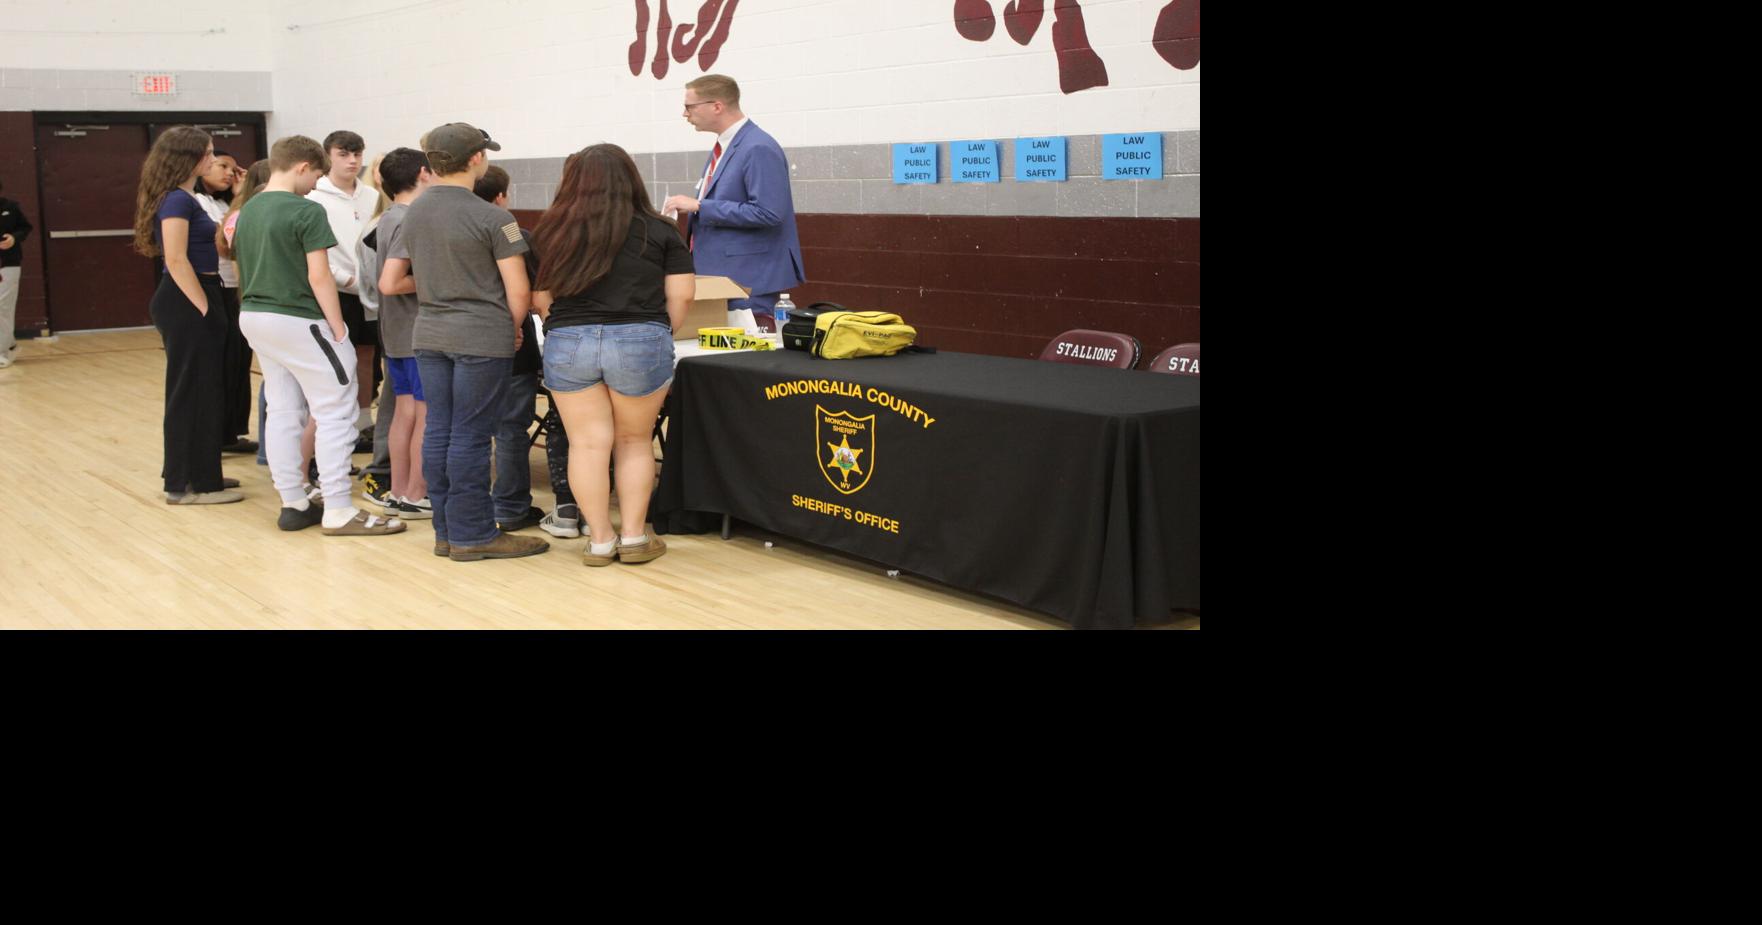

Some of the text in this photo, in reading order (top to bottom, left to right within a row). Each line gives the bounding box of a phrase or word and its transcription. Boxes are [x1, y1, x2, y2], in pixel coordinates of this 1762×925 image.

[143, 76, 171, 94] EXIT
[1032, 141, 1050, 149] LAW
[1123, 136, 1144, 145] LAW
[910, 146, 926, 154] LAW
[968, 143, 985, 152] LAW
[1026, 154, 1056, 163] PUBLIC
[1115, 151, 1151, 160] PUBLIC
[904, 159, 931, 167] PUBLIC
[962, 157, 991, 165] PUBLIC
[904, 172, 931, 180] SAFETY
[962, 170, 991, 179] SAFETY
[1026, 169, 1056, 177] SAFETY
[1115, 167, 1151, 176] SAFETY
[709, 335, 736, 349] LINE
[1056, 342, 1118, 362] STALLIONS
[1168, 357, 1200, 374] STA
[764, 379, 936, 429] MONONGALIA COUNTY
[824, 416, 866, 430] MONONGALIA
[832, 425, 858, 435] SHERIFF
[840, 481, 851, 490] WV
[791, 494, 900, 534] SHERIFF'S OFFICE
